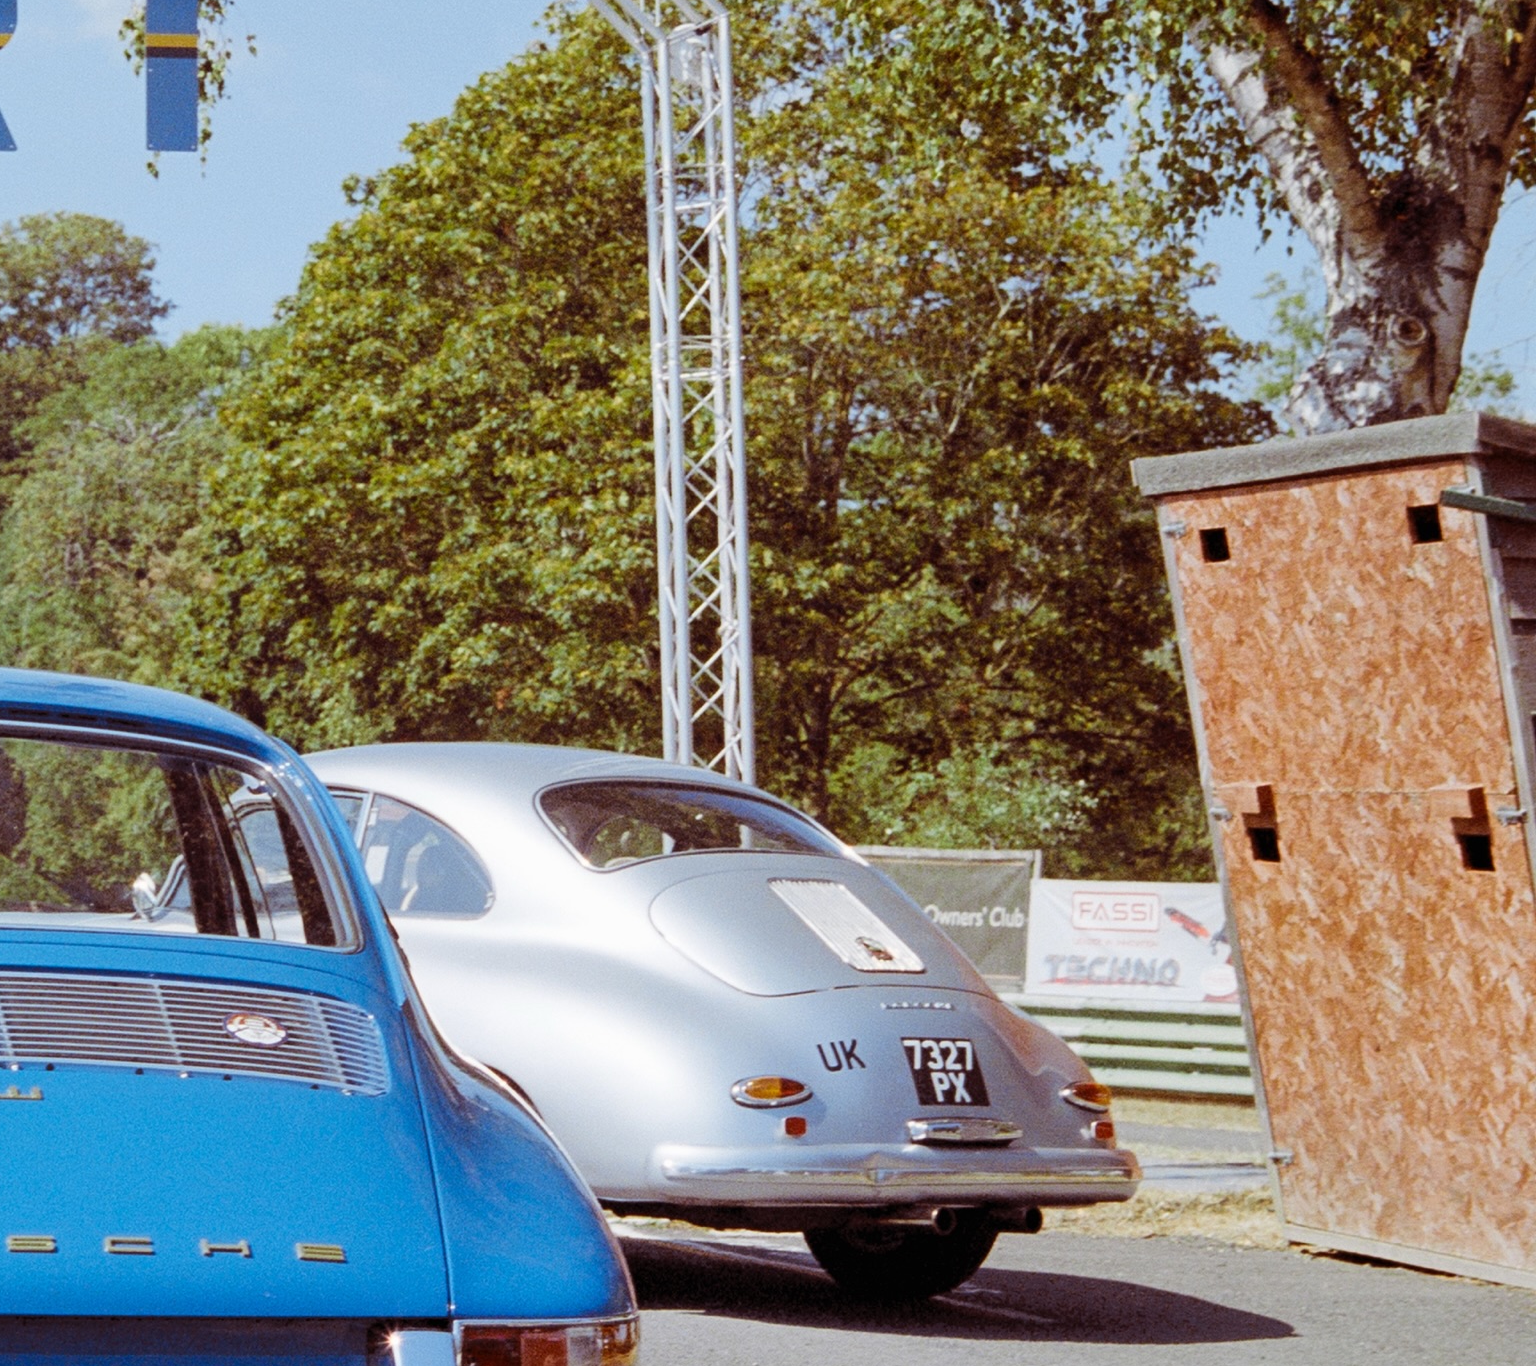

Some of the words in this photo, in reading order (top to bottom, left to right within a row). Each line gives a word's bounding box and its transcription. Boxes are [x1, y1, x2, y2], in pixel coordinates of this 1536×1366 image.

[924, 904, 988, 927] Owners'
[989, 906, 1025, 928] Club
[1078, 901, 1154, 922] FASSI
[1043, 953, 1181, 985] TECHNO
[816, 1039, 867, 1072] UK
[902, 1039, 974, 1071] 7327
[930, 1072, 972, 1104] PX
